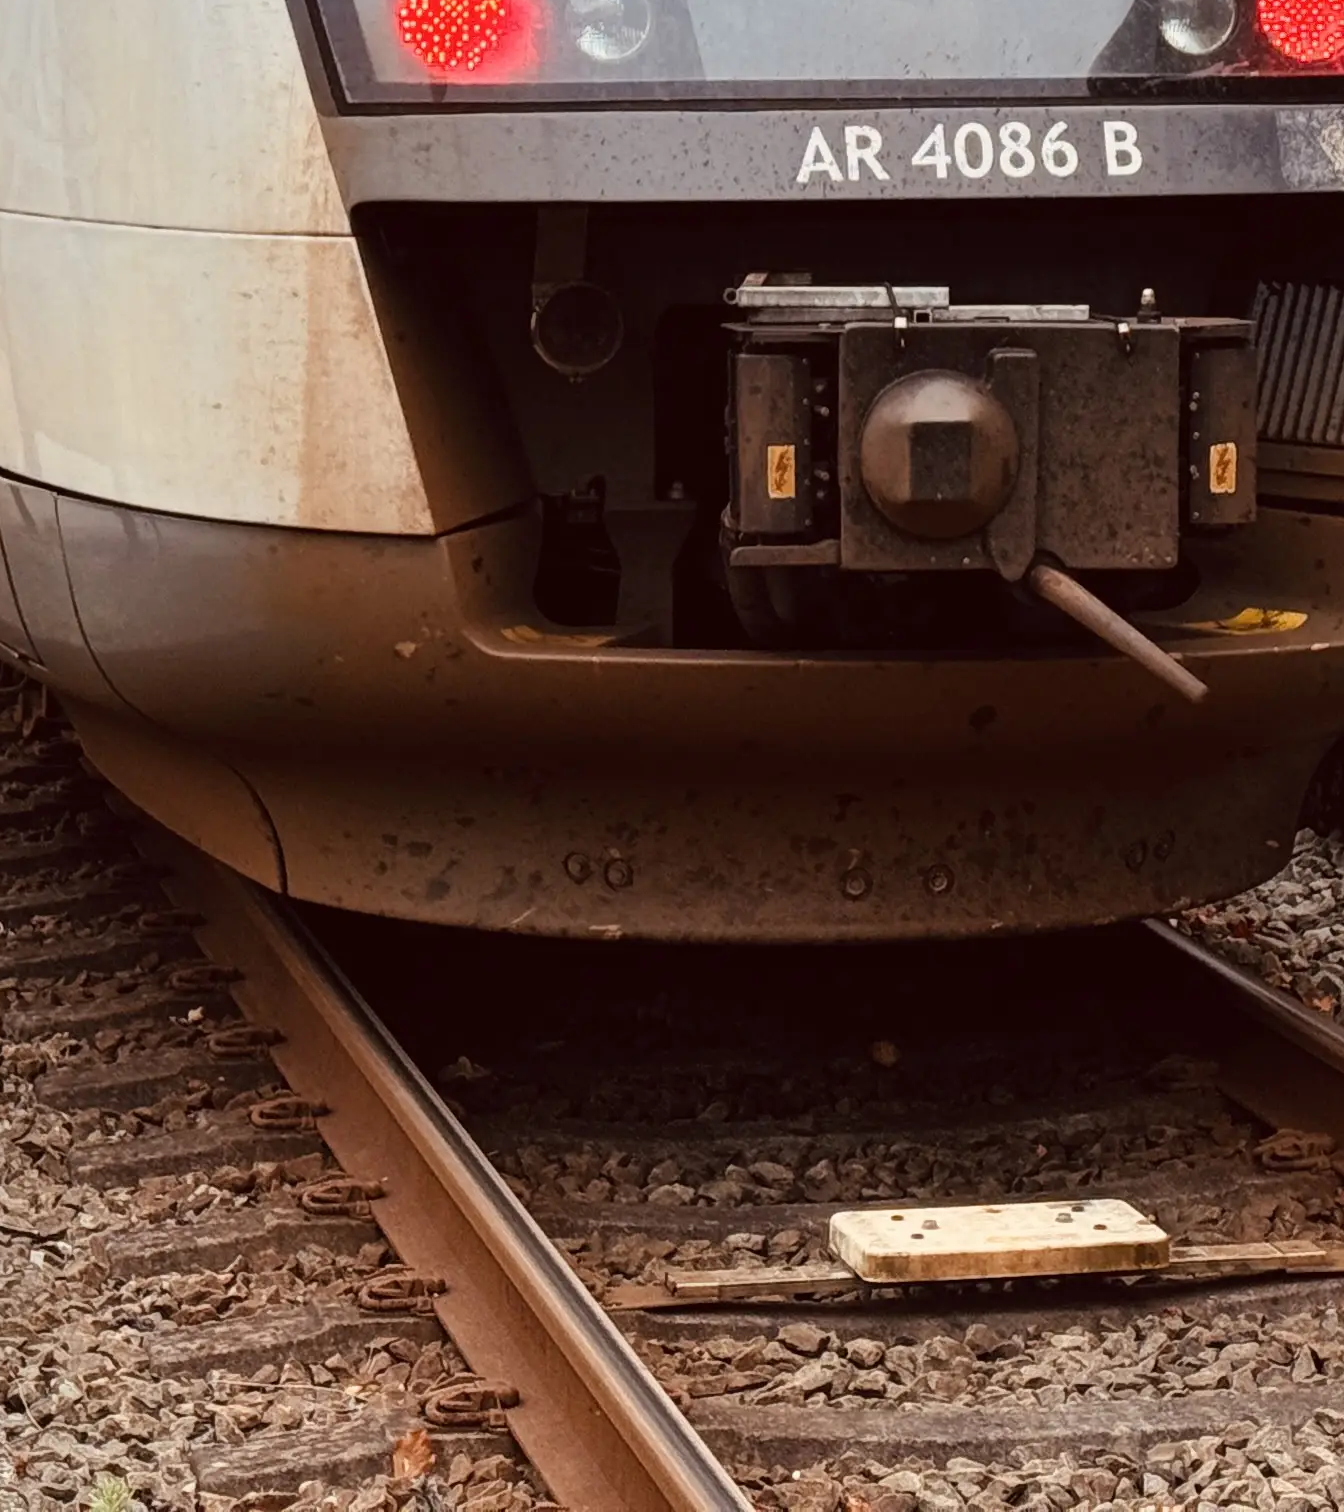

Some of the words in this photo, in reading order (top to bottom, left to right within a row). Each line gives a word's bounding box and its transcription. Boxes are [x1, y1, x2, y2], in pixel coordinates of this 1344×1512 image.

[796, 125, 891, 182] AR
[911, 121, 1079, 178] 4086
[1104, 121, 1143, 175] B
